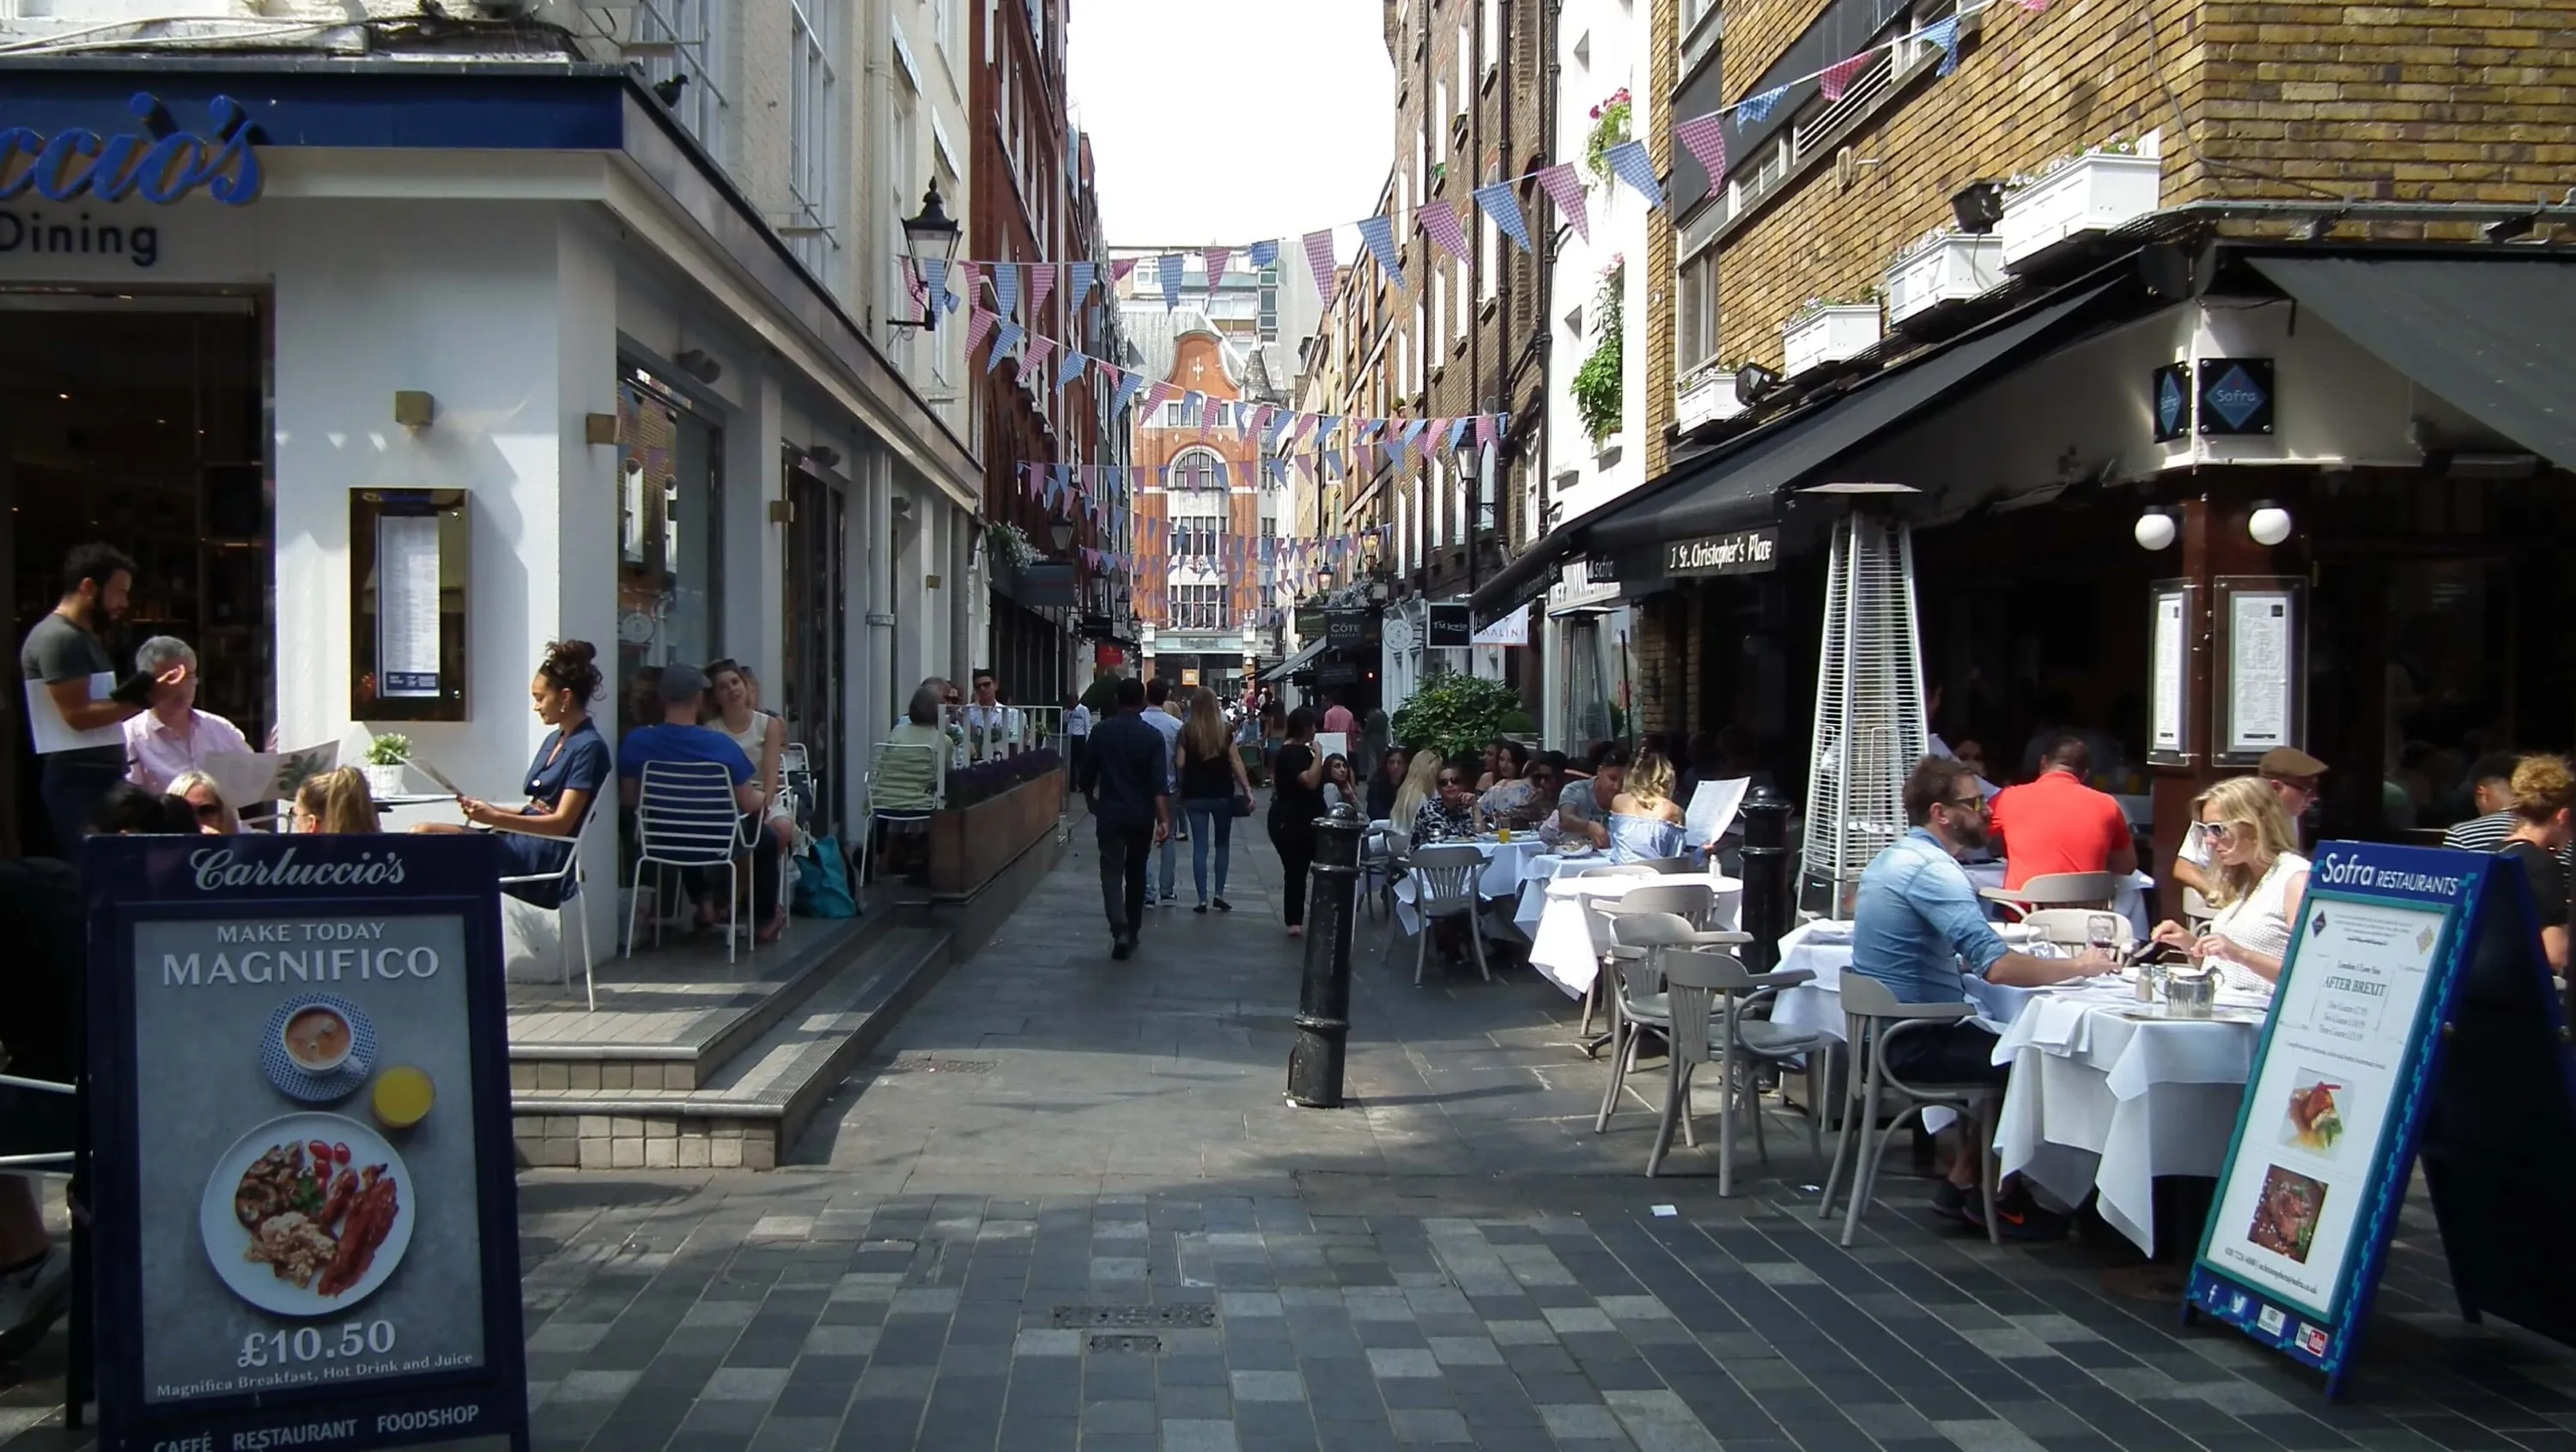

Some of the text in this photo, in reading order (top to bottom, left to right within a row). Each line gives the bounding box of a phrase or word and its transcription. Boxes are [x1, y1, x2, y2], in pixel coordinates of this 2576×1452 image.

[0, 213, 158, 267] Dining
[2216, 389, 2257, 403] Sofra
[1748, 533, 1773, 562] Place
[1331, 622, 1361, 633] CÔTE
[190, 847, 405, 890] Carluccio's
[2321, 853, 2459, 896] Sofra RESTAURANTS
[217, 922, 386, 944] MAKE TODAY
[163, 946, 440, 986] MAGNIFICO
[2322, 975, 2387, 996] AFTER BREXIT
[237, 1320, 397, 1368] £10.50
[157, 1352, 473, 1397] Magnifica Breakfast, Hot Drink and Juice
[234, 1419, 358, 1449] RESTAURANT
[377, 1405, 480, 1433] FOODSHOP
